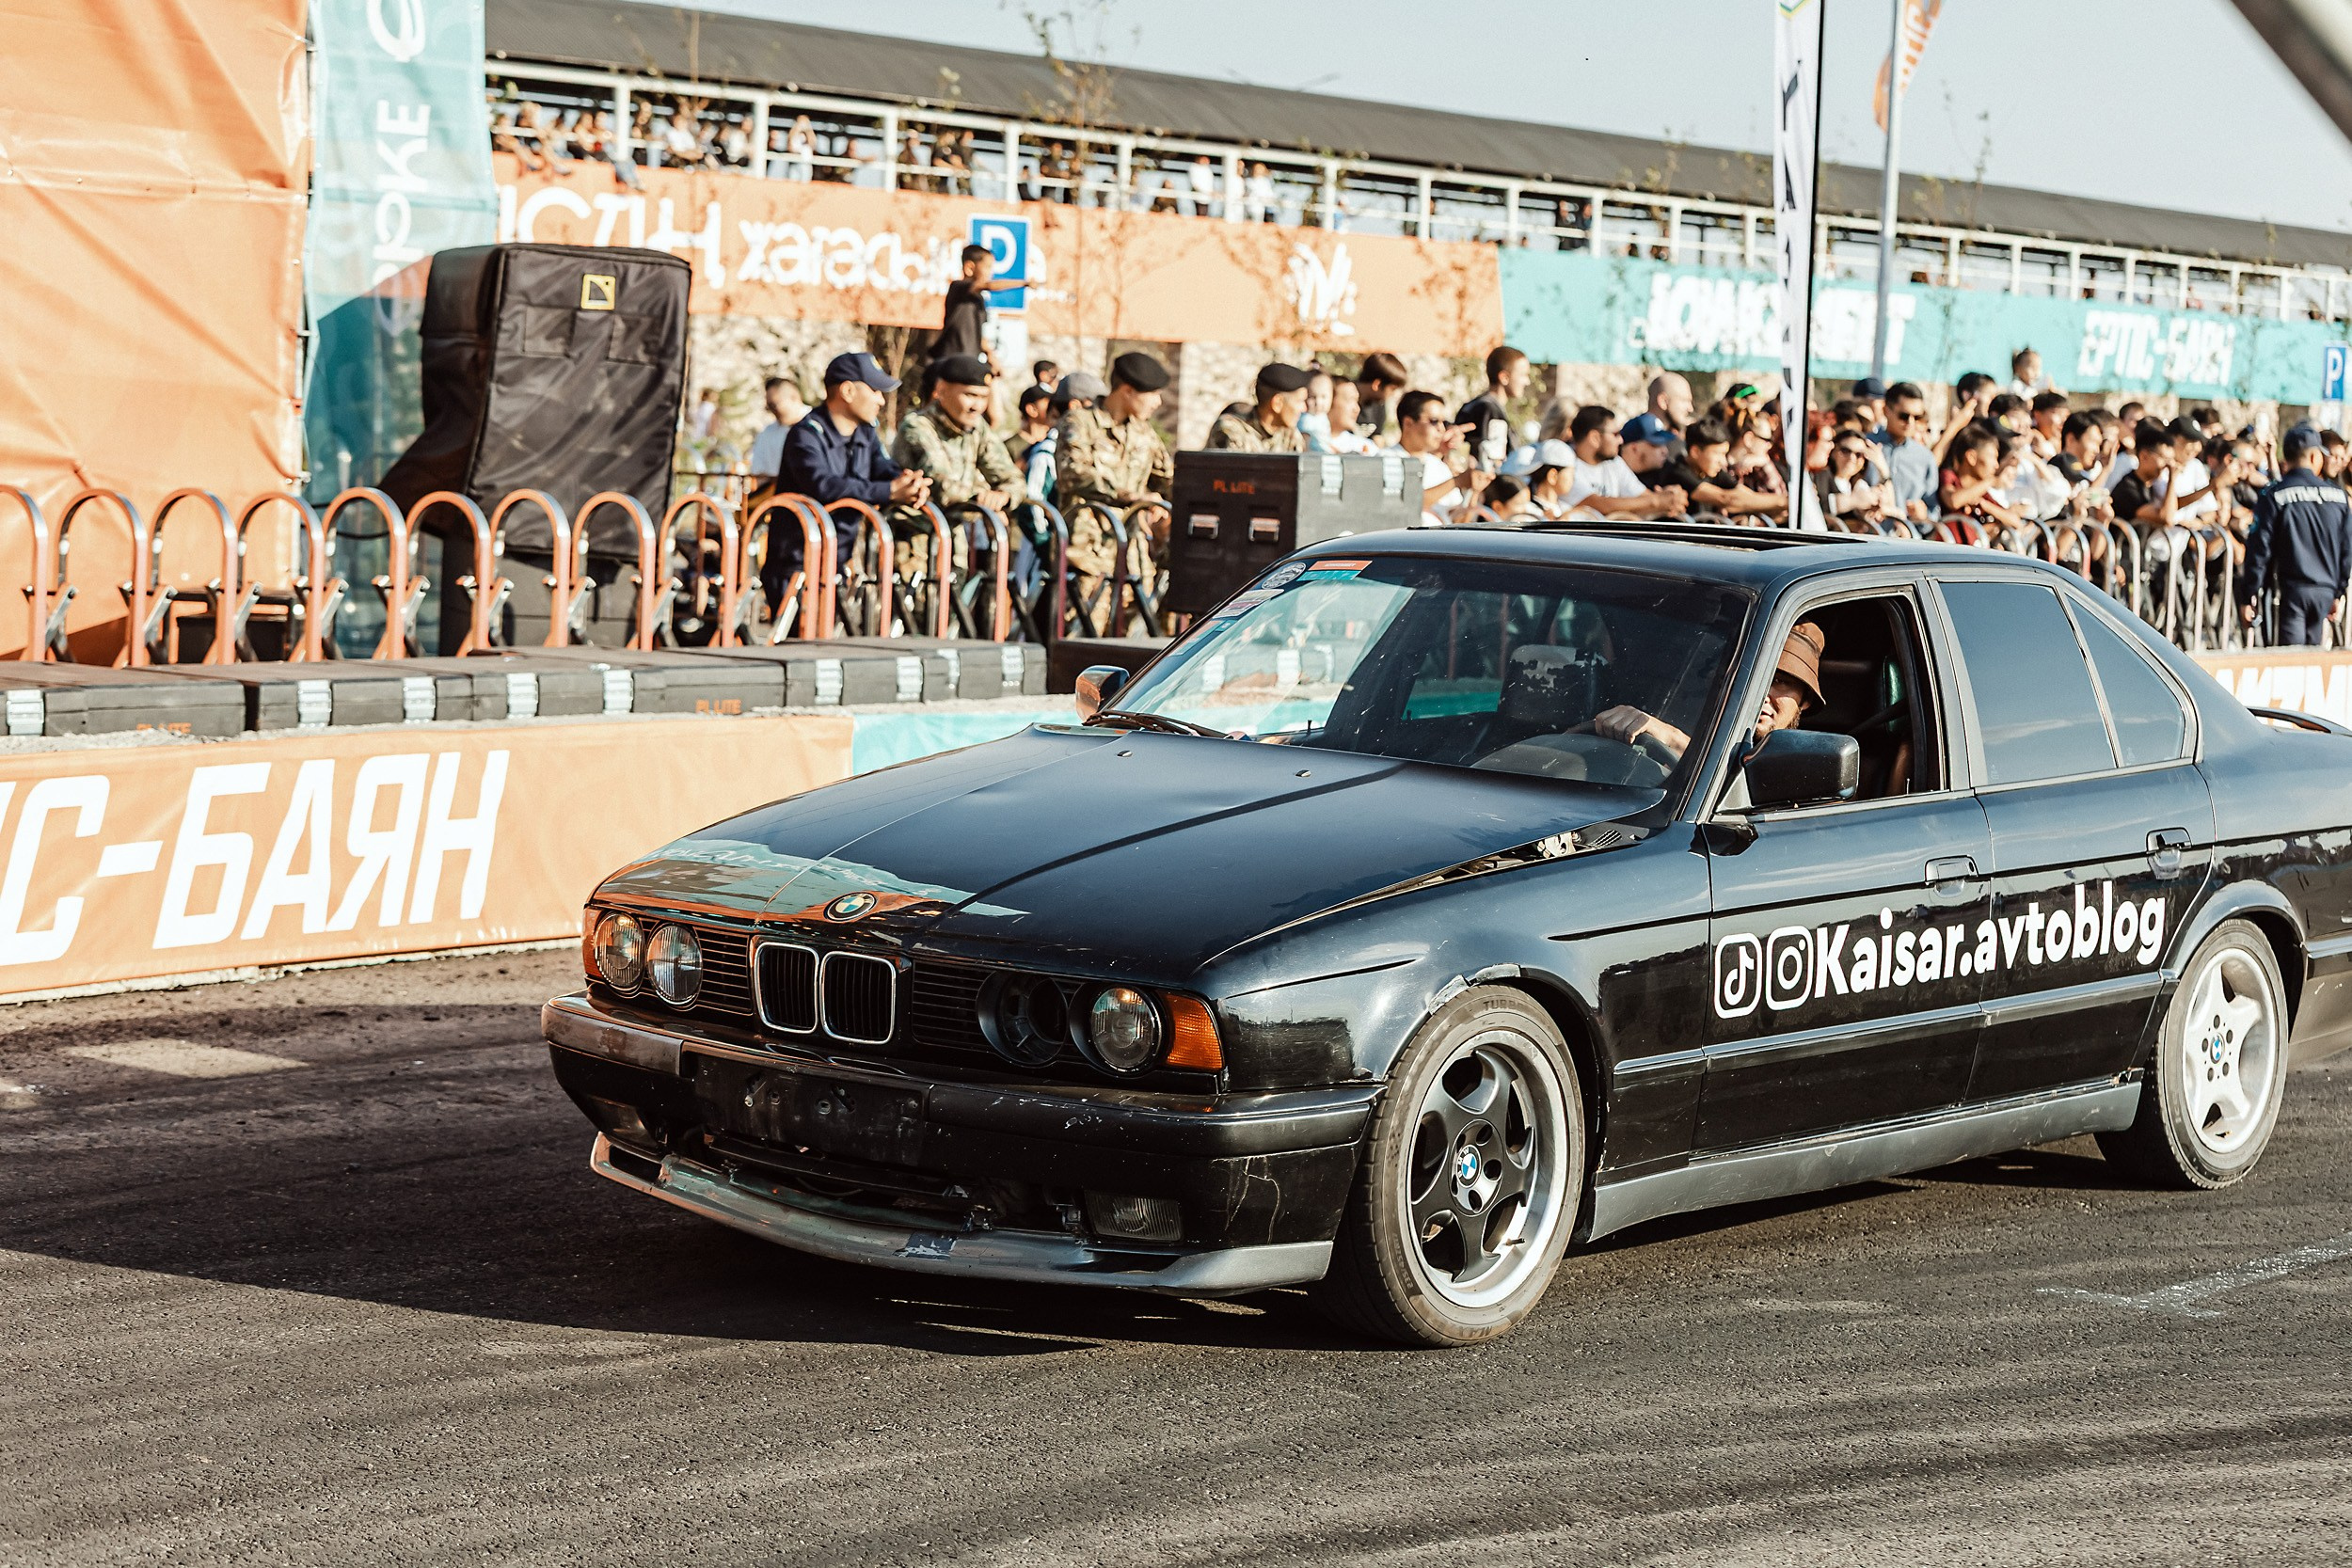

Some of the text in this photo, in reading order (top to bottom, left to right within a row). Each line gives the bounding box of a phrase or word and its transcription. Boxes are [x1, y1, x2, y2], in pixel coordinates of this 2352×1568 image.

[2326, 347, 2344, 398] P
[0, 750, 509, 966] С-БАЯН
[1814, 881, 2166, 999] Kaisar.avtoblog
